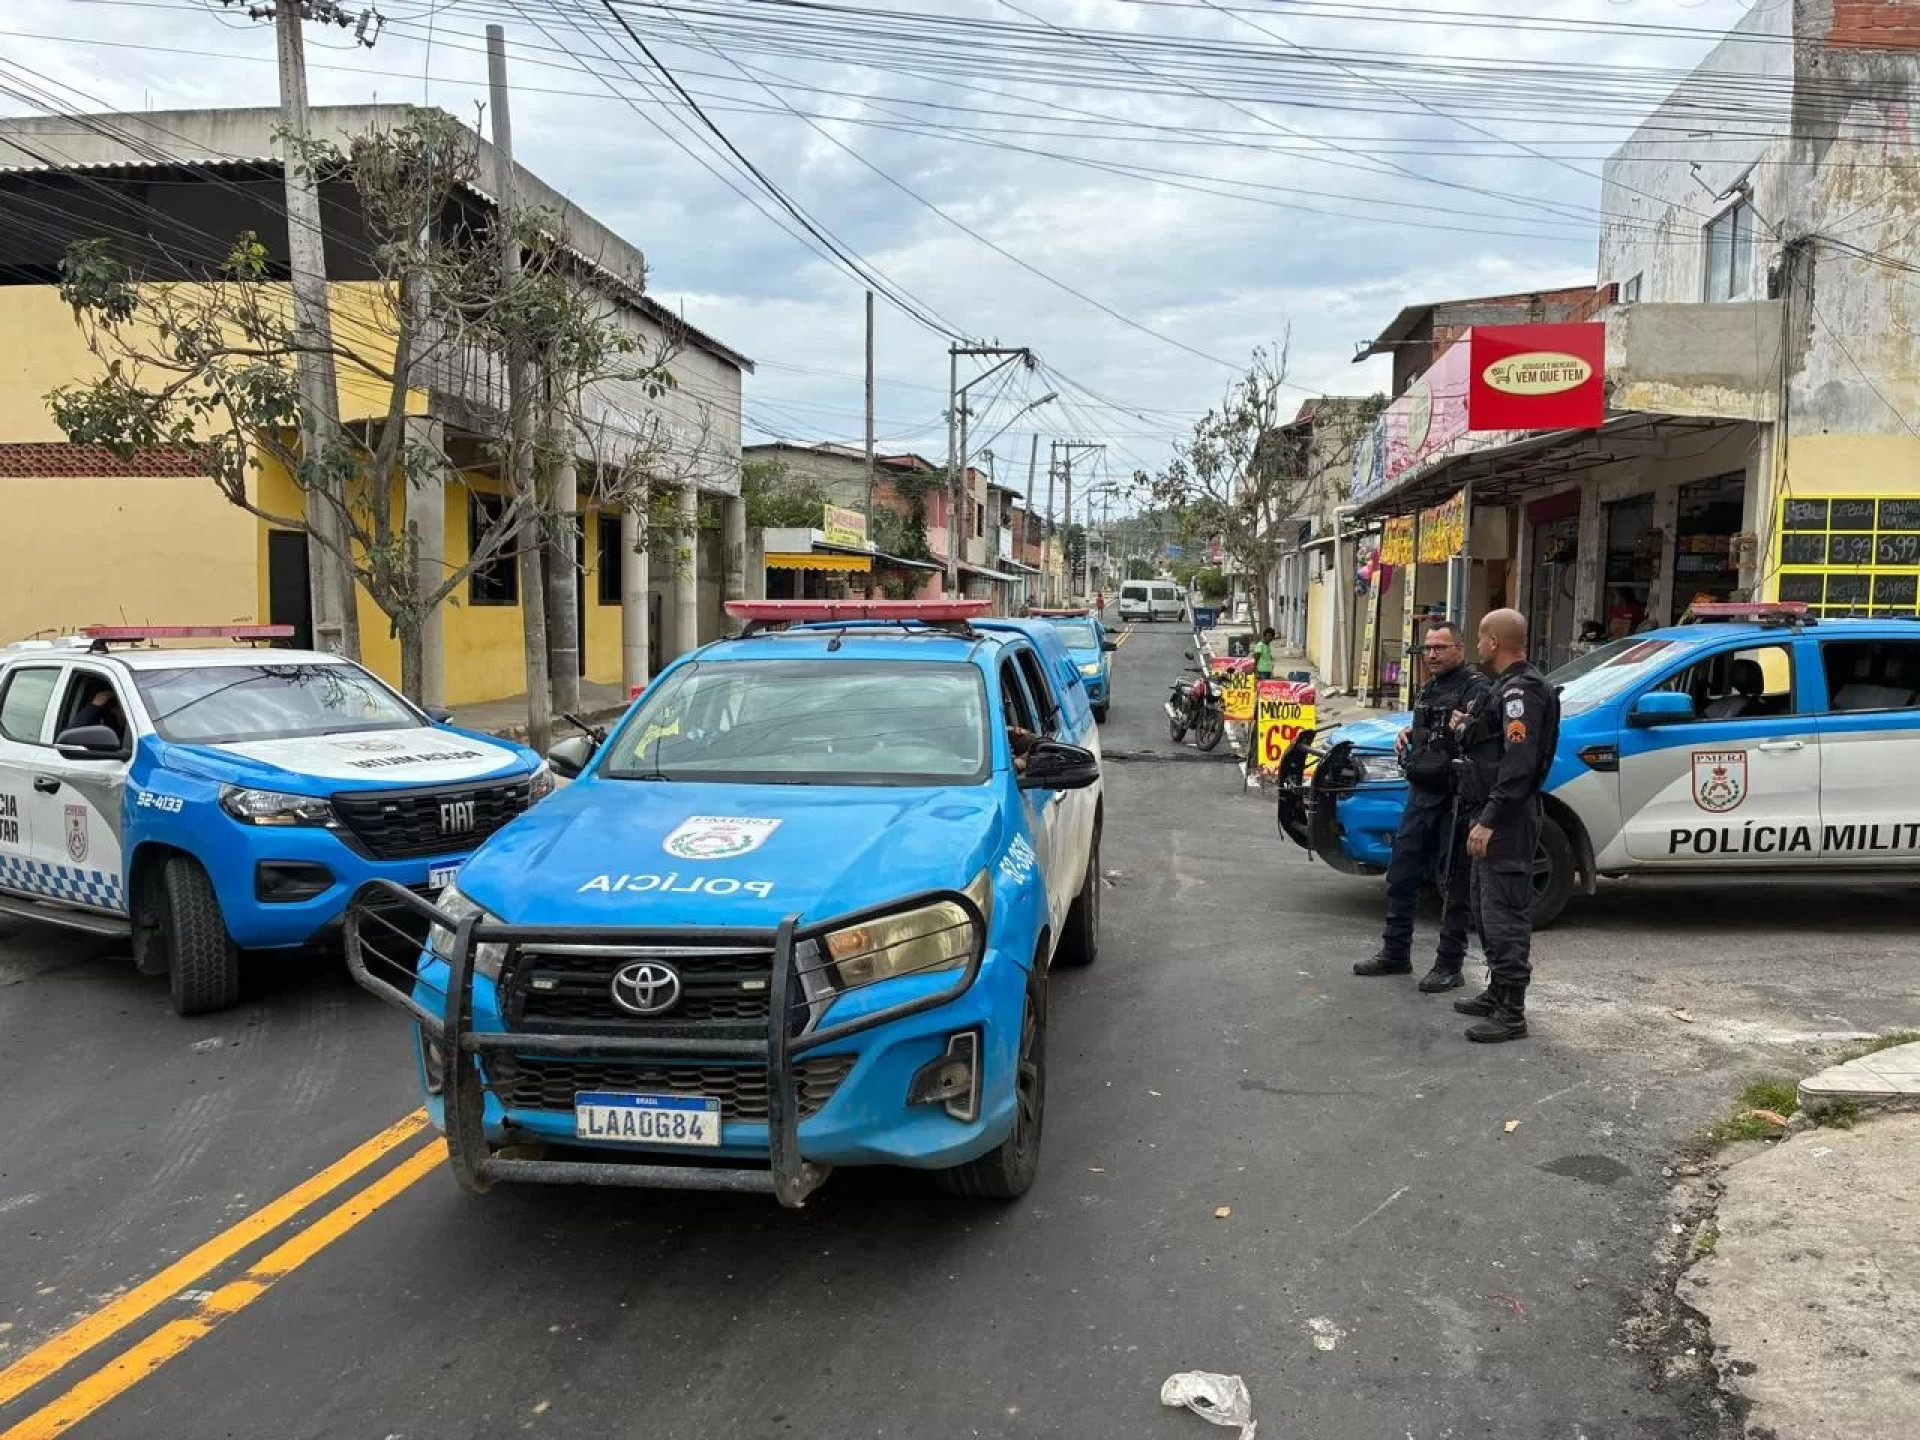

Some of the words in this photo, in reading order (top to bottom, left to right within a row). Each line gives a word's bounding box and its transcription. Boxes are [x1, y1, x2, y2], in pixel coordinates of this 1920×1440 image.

[1515, 371, 1537, 383] VEM
[1540, 370, 1560, 382] QUE
[1562, 368, 1584, 381] TEM
[1696, 755, 1743, 763] PMERJ
[439, 800, 475, 834] FIAT
[1668, 820, 1812, 854] POLÍCIA
